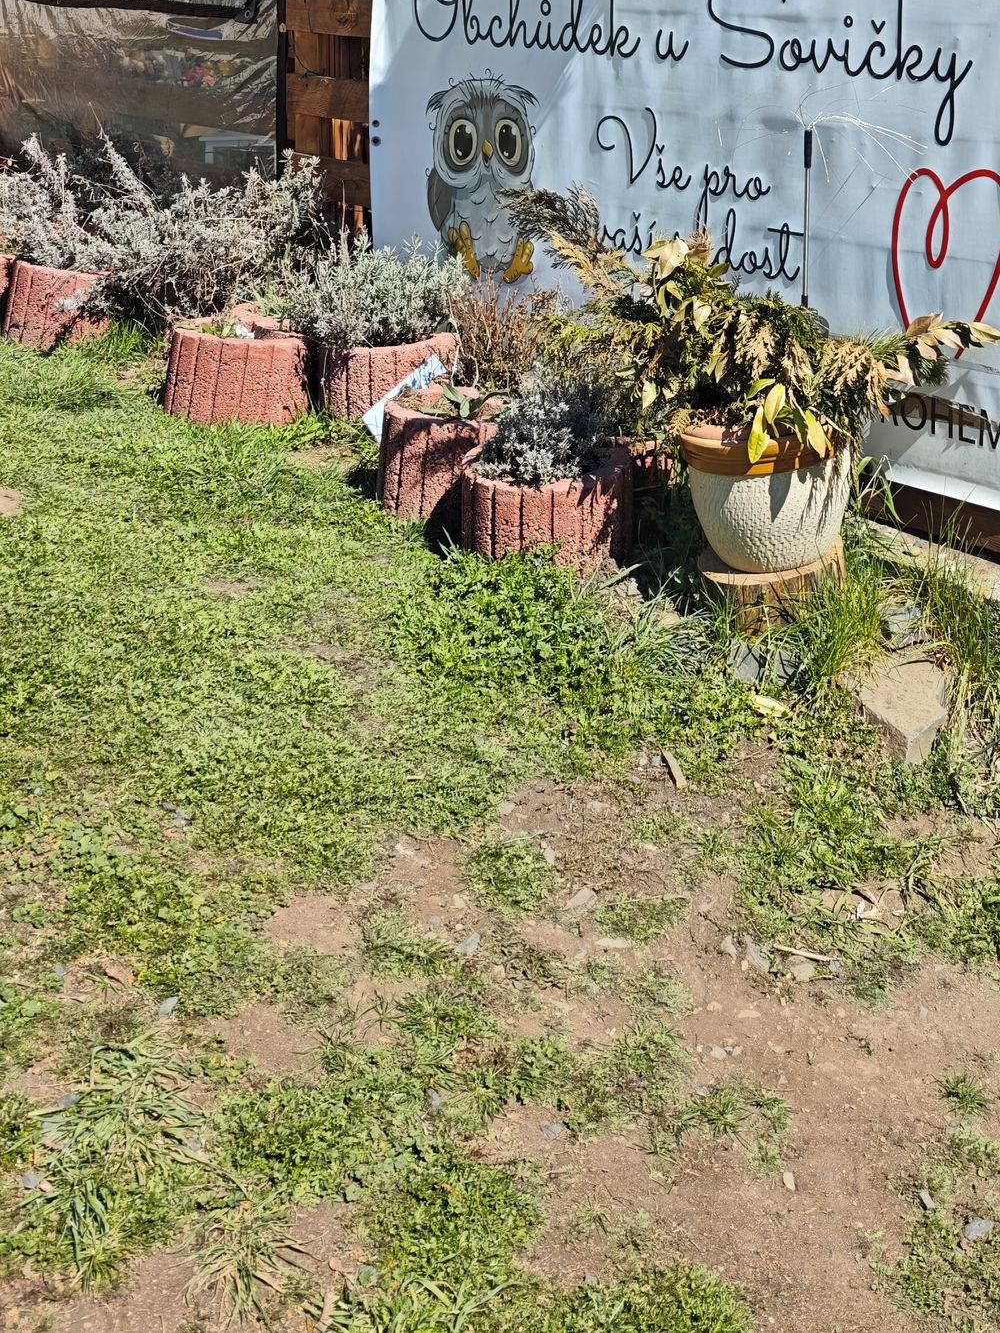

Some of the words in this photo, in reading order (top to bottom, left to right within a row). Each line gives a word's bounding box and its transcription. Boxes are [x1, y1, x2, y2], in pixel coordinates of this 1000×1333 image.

[655, 23, 690, 63] u
[596, 107, 692, 191] Vše
[695, 163, 772, 235] pro
[673, 208, 805, 281] dost
